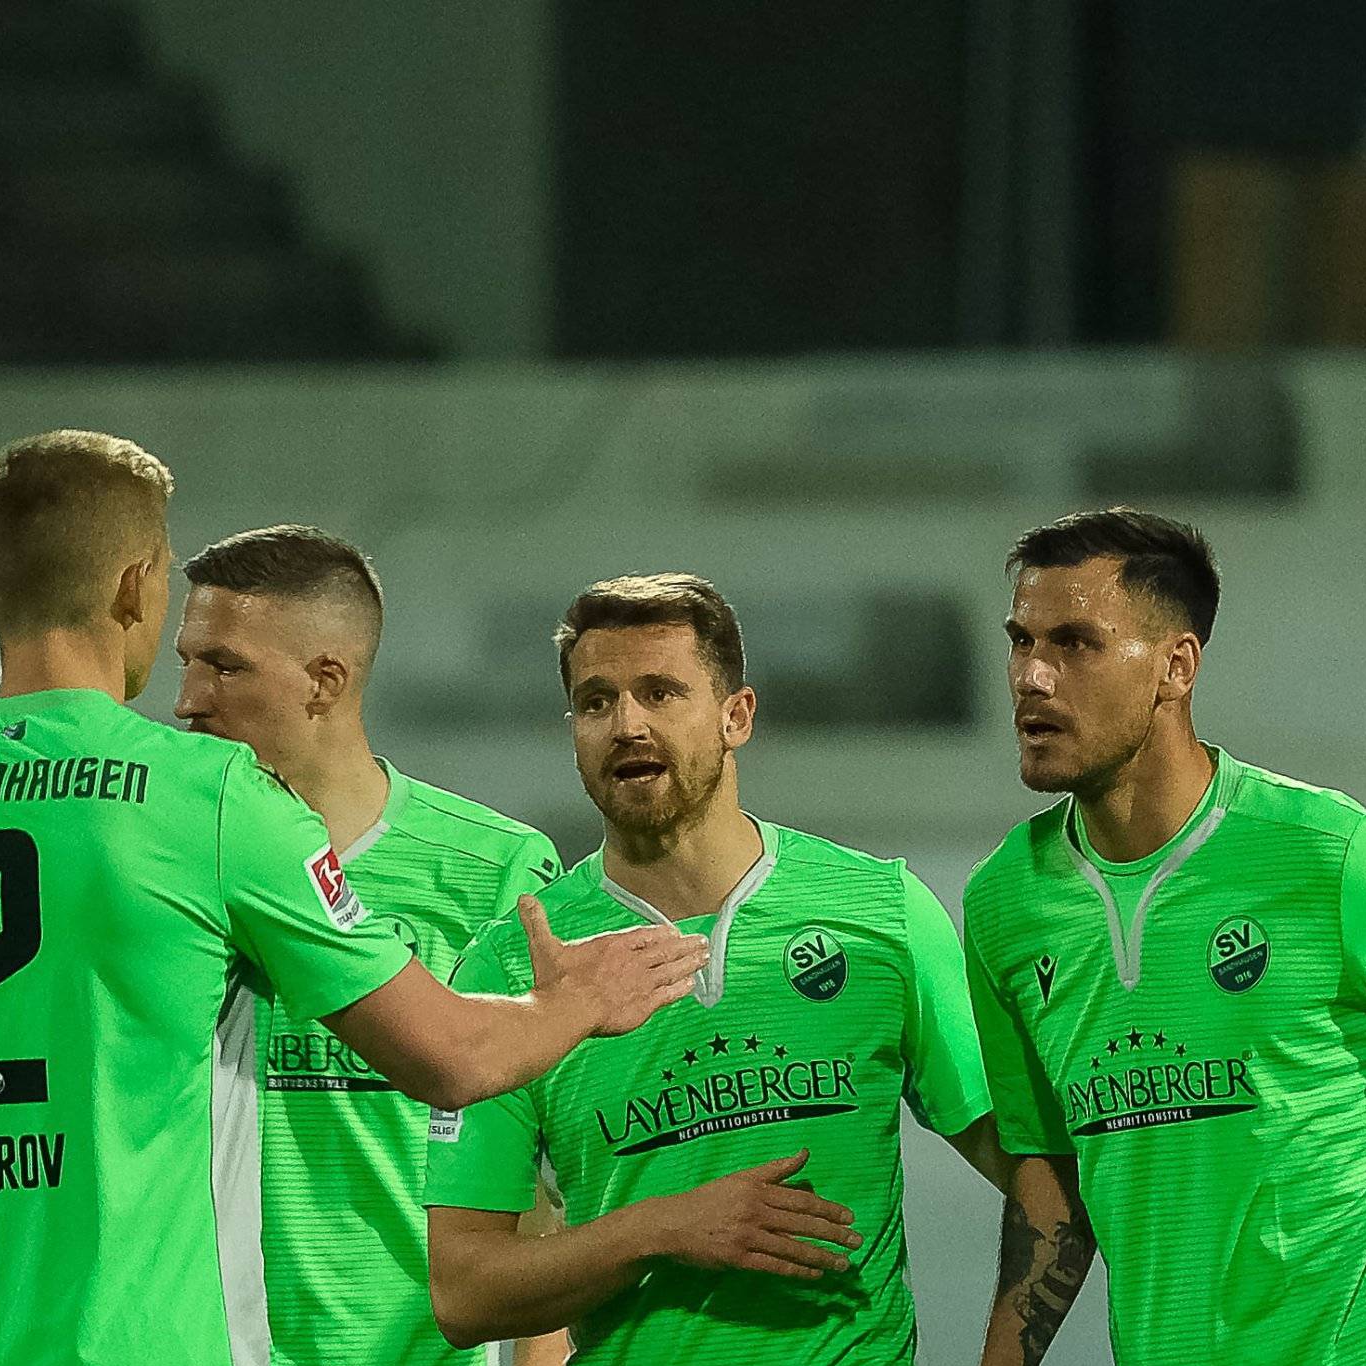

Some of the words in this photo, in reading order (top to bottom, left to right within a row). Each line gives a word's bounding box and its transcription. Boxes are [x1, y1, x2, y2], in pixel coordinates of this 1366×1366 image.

[790, 934, 827, 968] SV
[1215, 922, 1250, 957] SV
[595, 1058, 858, 1145] LAYENBERGER
[1066, 1058, 1257, 1124] AYENBERGER
